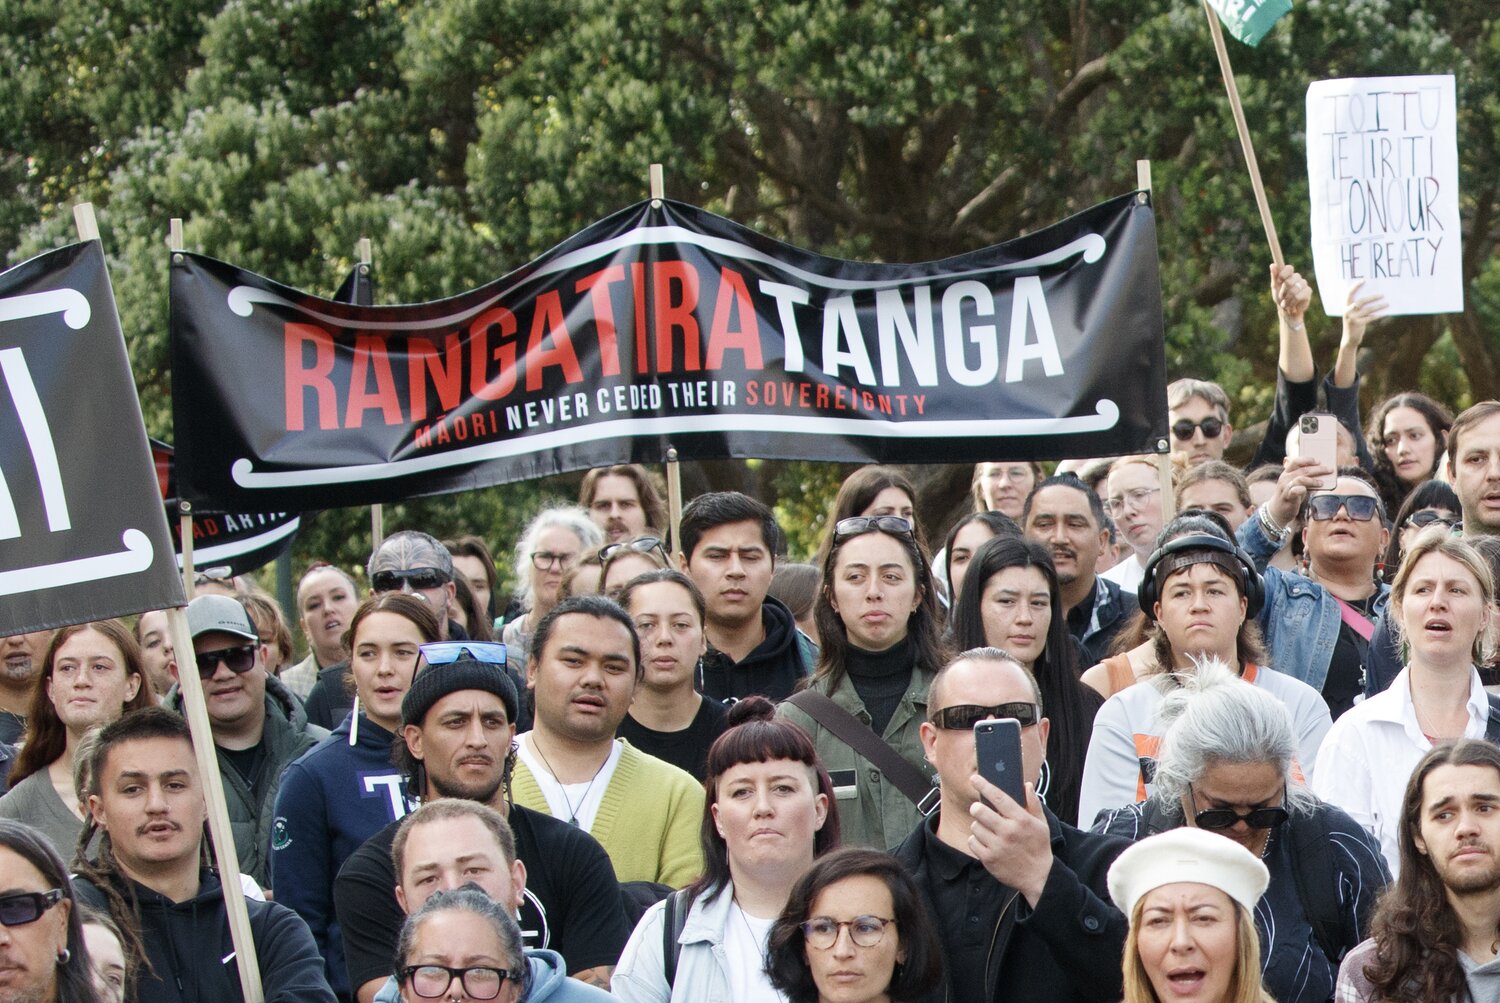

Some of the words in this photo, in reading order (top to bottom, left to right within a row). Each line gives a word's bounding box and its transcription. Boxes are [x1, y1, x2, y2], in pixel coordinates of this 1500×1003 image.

[284, 260, 1064, 432] RANGATIRATANGA
[415, 411, 497, 449] MĀORI
[506, 392, 589, 431] NEVER
[596, 383, 661, 414] CEDED
[668, 380, 736, 408] THEIR
[746, 380, 926, 416] SOVEREIGNTY
